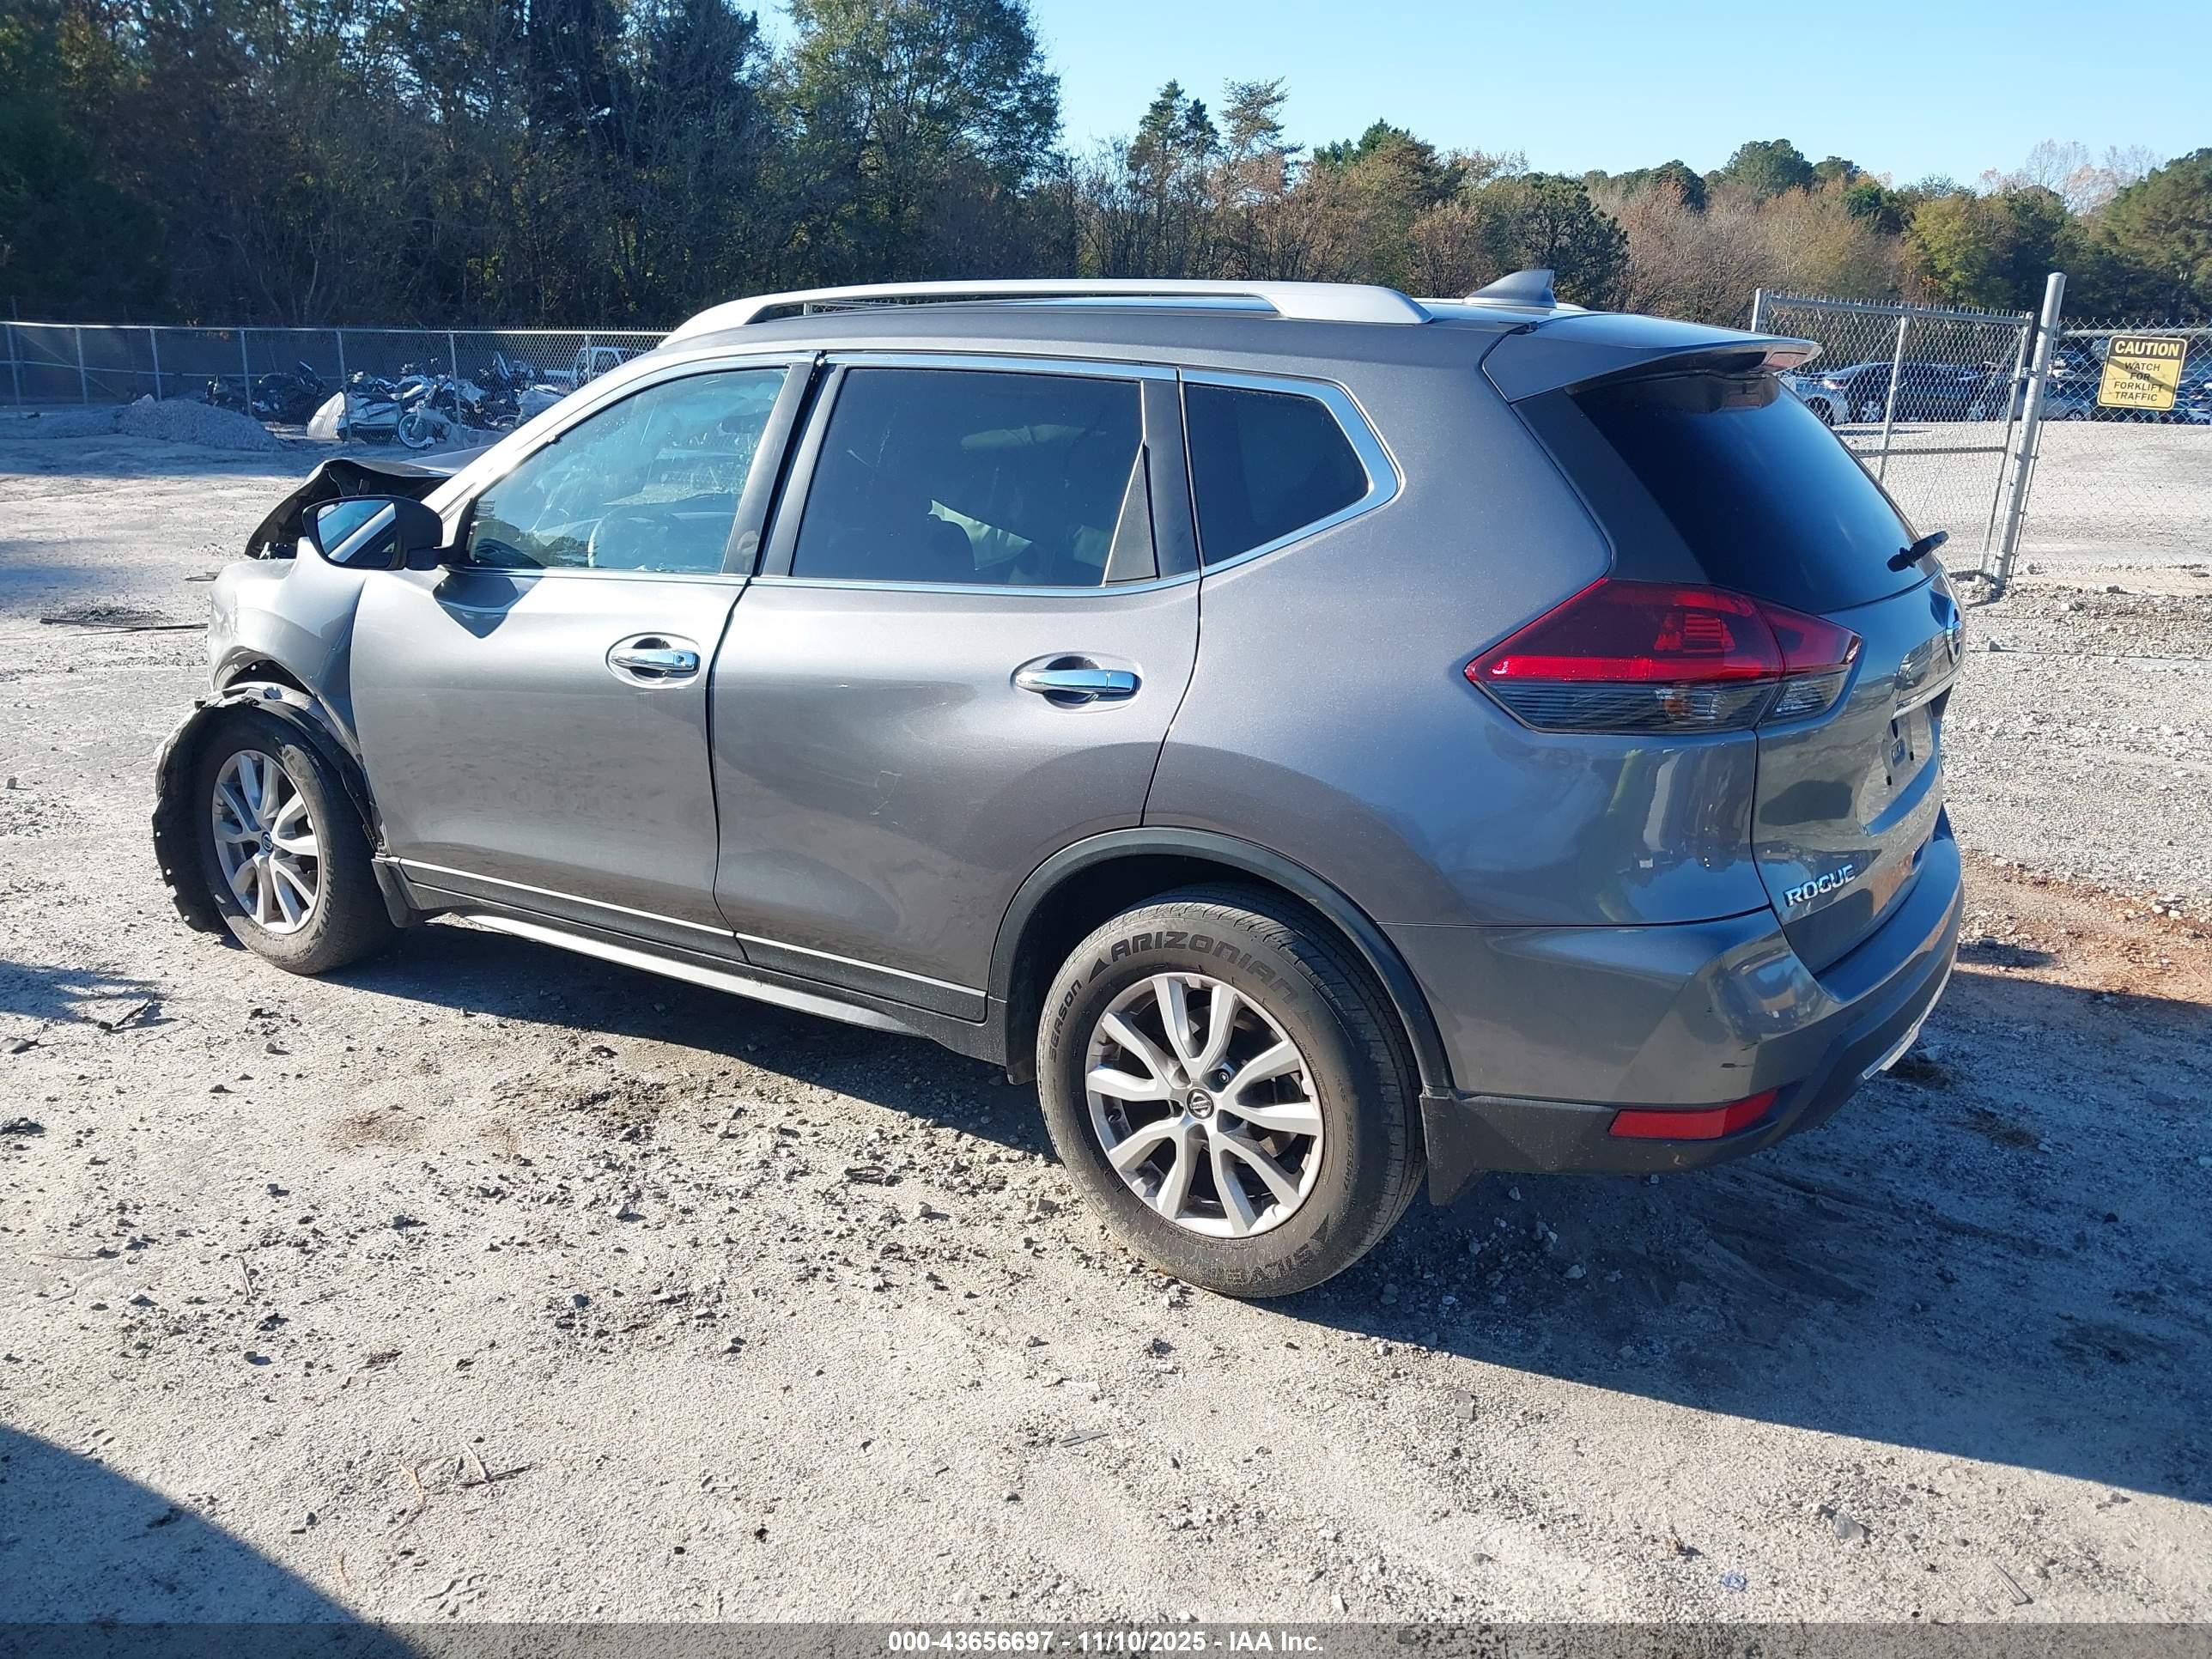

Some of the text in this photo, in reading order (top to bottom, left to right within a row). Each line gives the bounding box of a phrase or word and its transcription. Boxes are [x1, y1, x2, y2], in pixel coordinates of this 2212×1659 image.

[2115, 341, 2179, 356] CAUTION
[2125, 362, 2160, 371] WATCH
[2114, 380, 2163, 392] FORKLIFT
[2115, 391, 2158, 401] TRAFFIC
[1784, 864, 1856, 907] ROGUE
[1110, 931, 1300, 1004] ARIZONIAN
[1047, 979, 1084, 1062] SEASON
